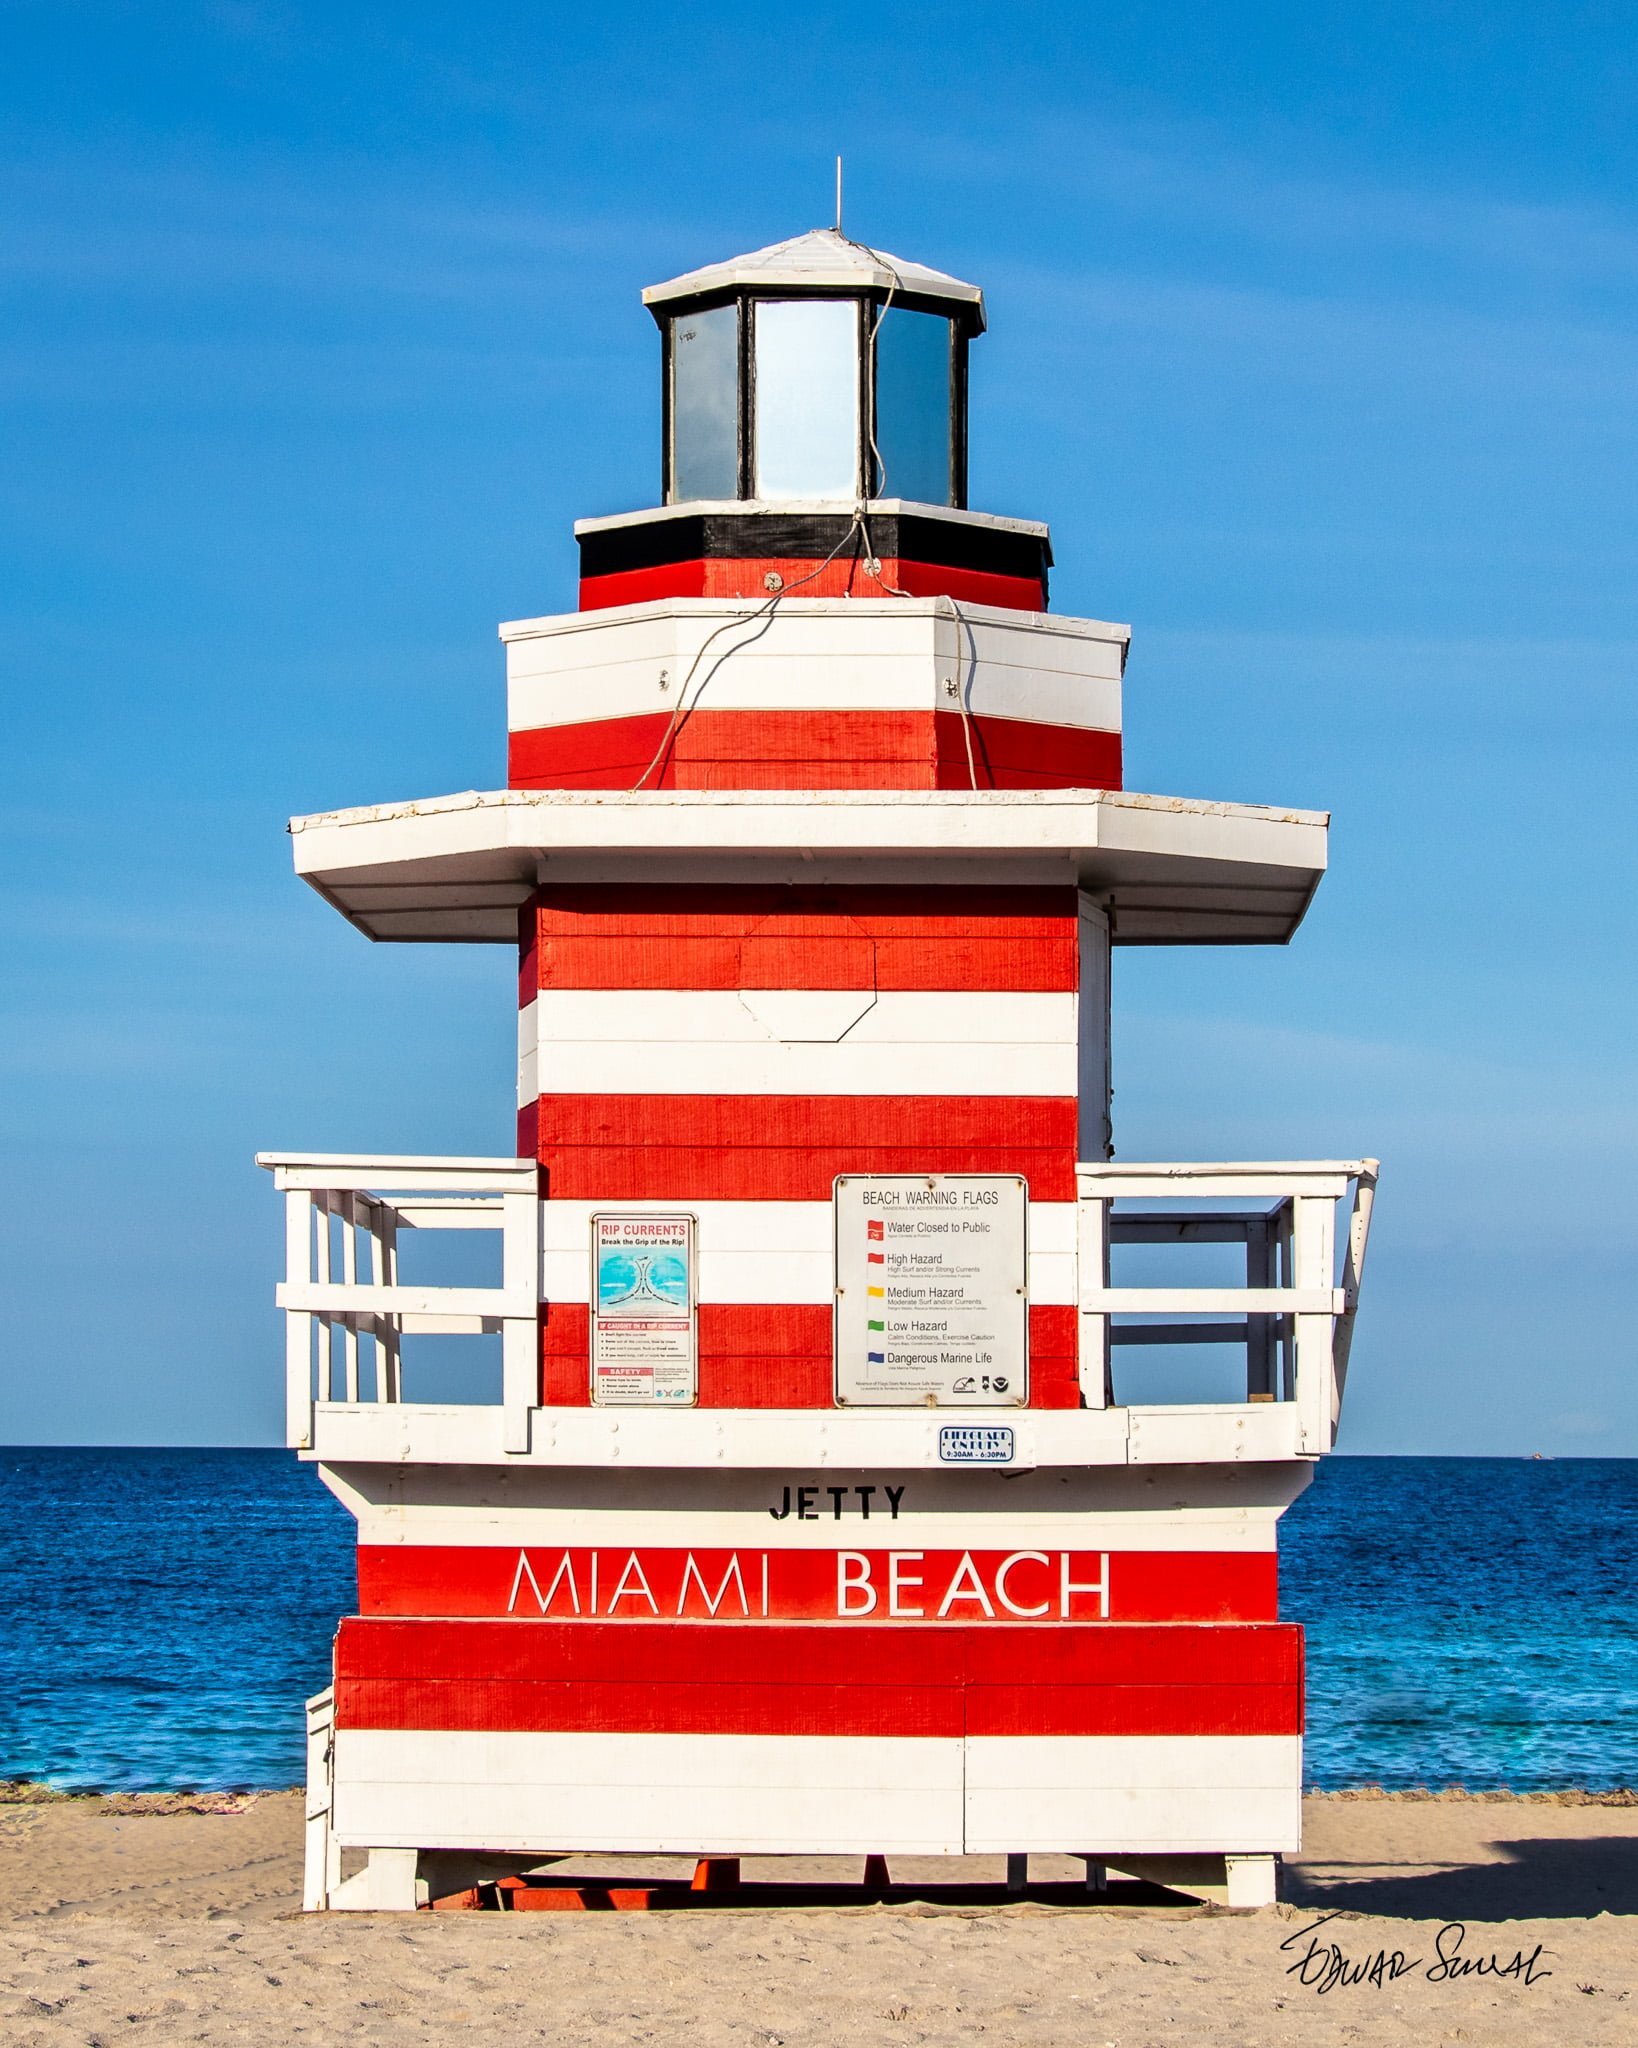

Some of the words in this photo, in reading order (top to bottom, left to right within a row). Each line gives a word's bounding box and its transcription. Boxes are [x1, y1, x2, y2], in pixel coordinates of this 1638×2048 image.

[863, 1191, 900, 1205] BEACH
[906, 1191, 957, 1205] WARNING
[964, 1191, 998, 1205] FLAGS
[602, 1225, 620, 1235] RIP
[624, 1225, 686, 1235] CURRENTS
[888, 1222, 914, 1233] Water
[917, 1222, 949, 1233] Closed
[951, 1222, 960, 1233] to
[963, 1222, 990, 1233] Public
[888, 1254, 908, 1266] High
[910, 1254, 942, 1264] Hazard
[888, 1288, 926, 1298] Medium
[929, 1288, 963, 1298] Hazard
[888, 1321, 908, 1331] Low
[912, 1321, 947, 1331] Hazard
[888, 1353, 938, 1365] Dangerous
[941, 1353, 972, 1363] Marine
[976, 1353, 992, 1363] Life
[944, 1431, 1008, 1440] LIFEGUARD
[768, 1486, 906, 1521] JETTY
[507, 1549, 770, 1617] MIAMI
[837, 1551, 1111, 1619] BEACH
